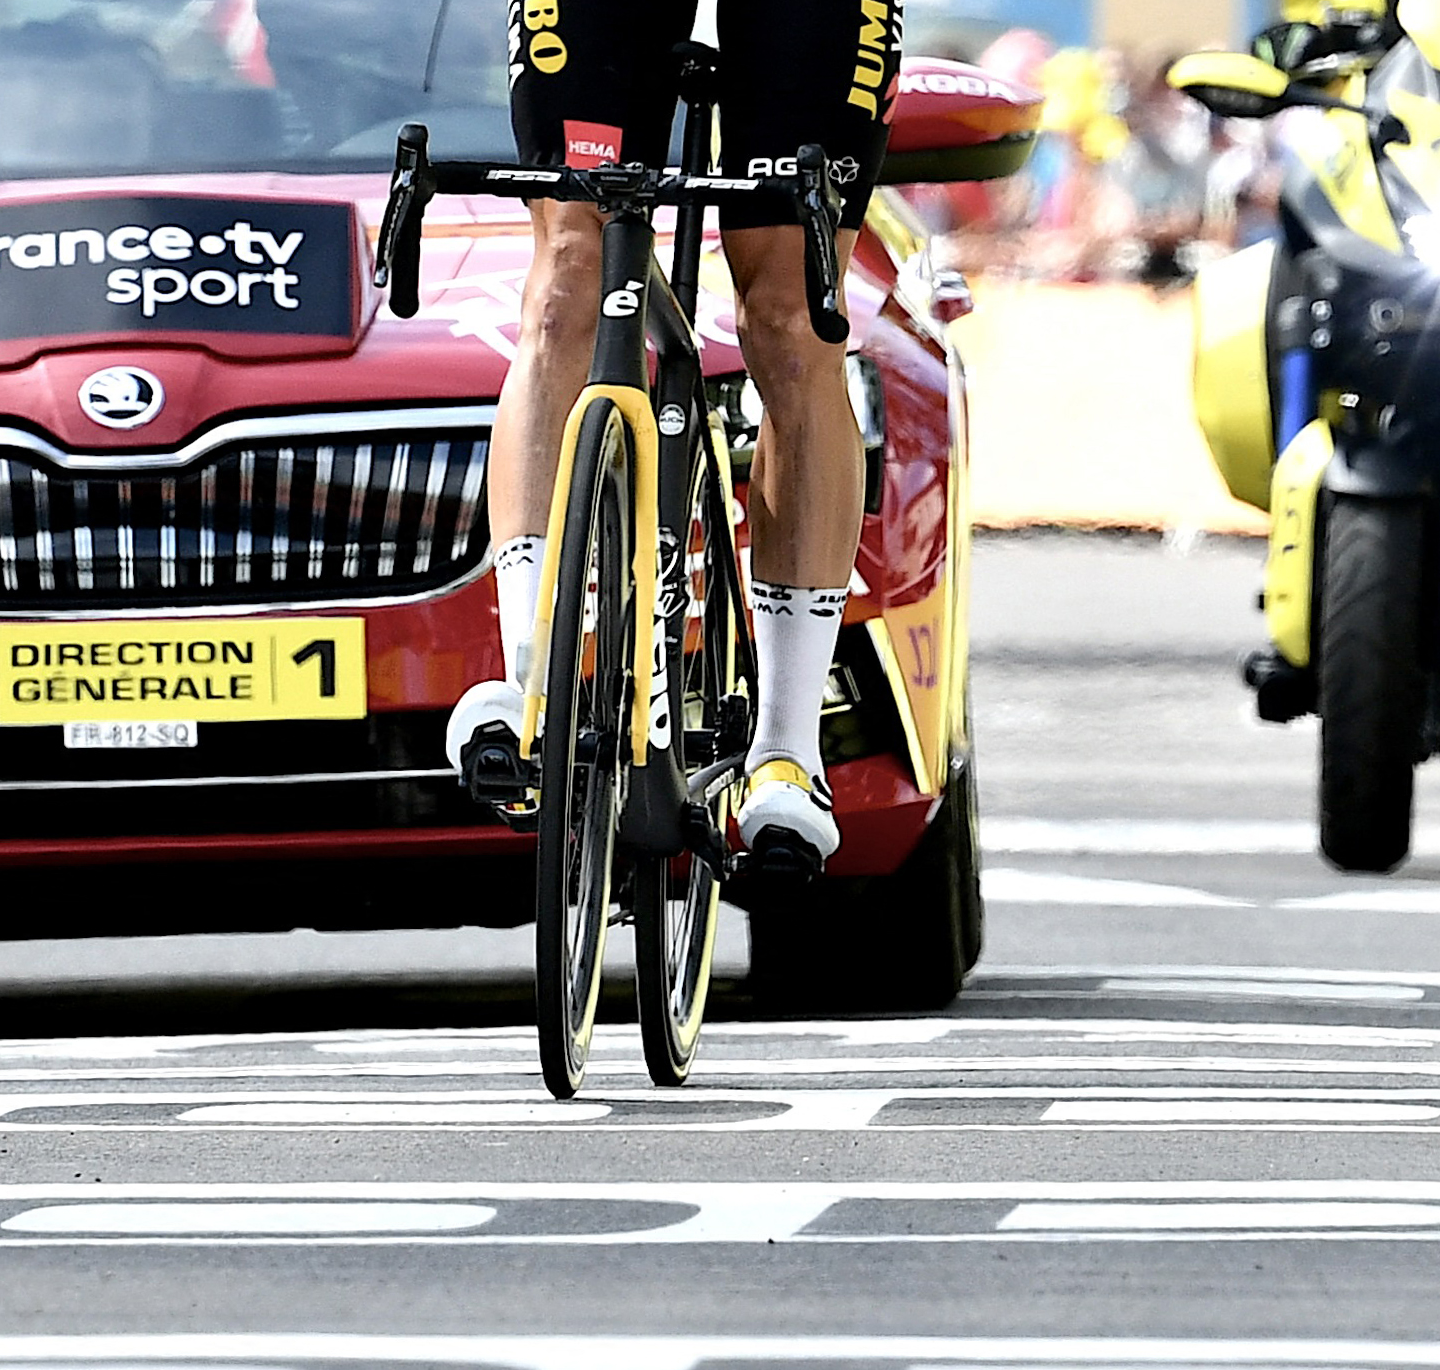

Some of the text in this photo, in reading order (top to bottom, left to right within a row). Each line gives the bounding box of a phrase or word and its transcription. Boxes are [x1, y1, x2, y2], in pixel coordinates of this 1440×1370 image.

[898, 73, 1021, 105] KODA
[568, 140, 616, 160] HEMA
[747, 157, 798, 178] AG
[106, 267, 300, 317] sport
[11, 640, 254, 667] DIRECTION
[291, 639, 337, 698] 1
[12, 671, 254, 703] GÉNÉRALE
